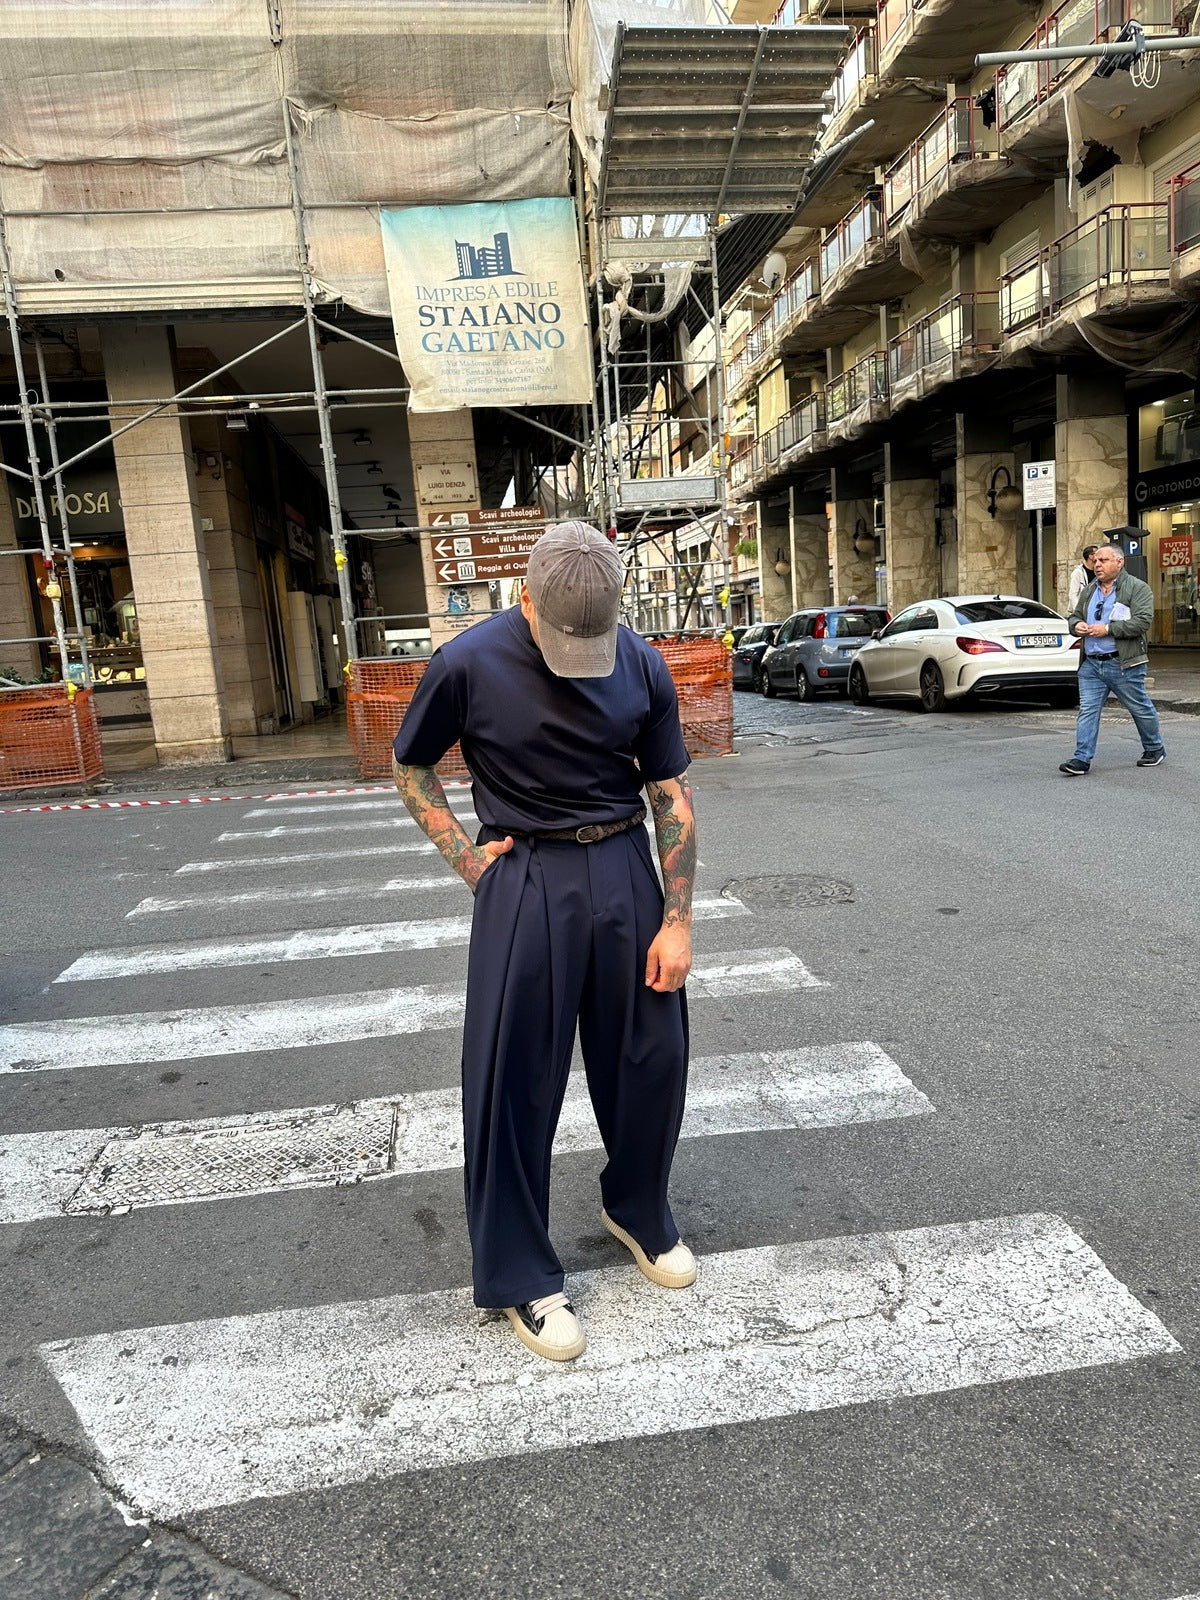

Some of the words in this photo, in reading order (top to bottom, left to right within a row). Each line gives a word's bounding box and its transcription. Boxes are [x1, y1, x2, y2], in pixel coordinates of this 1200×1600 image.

[416, 285, 500, 302] IMPRESA
[505, 281, 559, 298] EDILE
[418, 302, 561, 327] STAIANO
[421, 328, 565, 353] GAETANO
[479, 510, 498, 519] Scavi
[500, 507, 541, 518] archeologici
[481, 535, 500, 544] Scavi
[1163, 540, 1188, 549] TUTTO
[498, 544, 516, 553] Villa
[1162, 551, 1190, 566] 50%
[477, 563, 502, 573] Reggia
